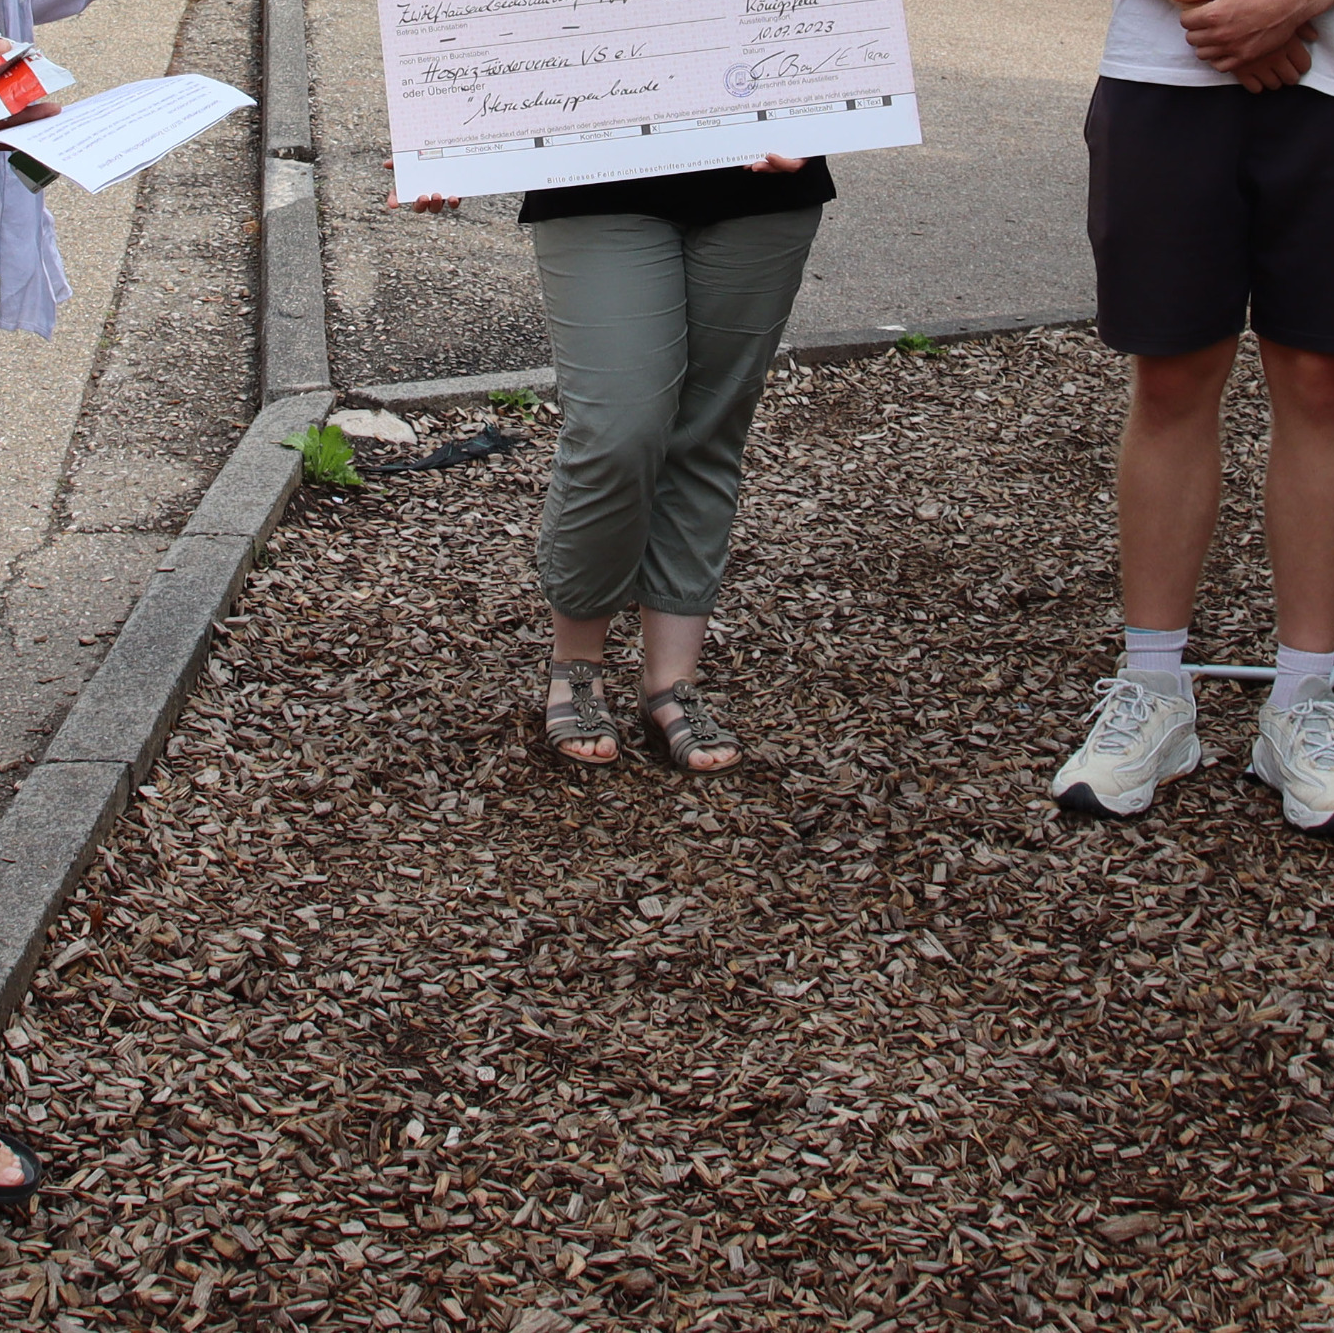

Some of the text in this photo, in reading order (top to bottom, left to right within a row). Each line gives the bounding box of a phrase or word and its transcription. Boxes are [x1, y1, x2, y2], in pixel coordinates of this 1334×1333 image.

[395, 27, 419, 36] Betrag
[427, 22, 468, 33] Buchstaben
[741, 46, 765, 55] Datum
[398, 57, 416, 65] noch
[416, 55, 440, 63] Betrag
[448, 49, 490, 60] Buchstaben
[401, 77, 414, 86] an
[787, 78, 800, 86] des
[401, 80, 485, 99] oder Überbringer
[788, 103, 833, 115] Bankleitzahl
[695, 118, 721, 127] Betrag
[546, 151, 769, 184] Bitte dieses Feld nicht beschriften und nicht bestempel
